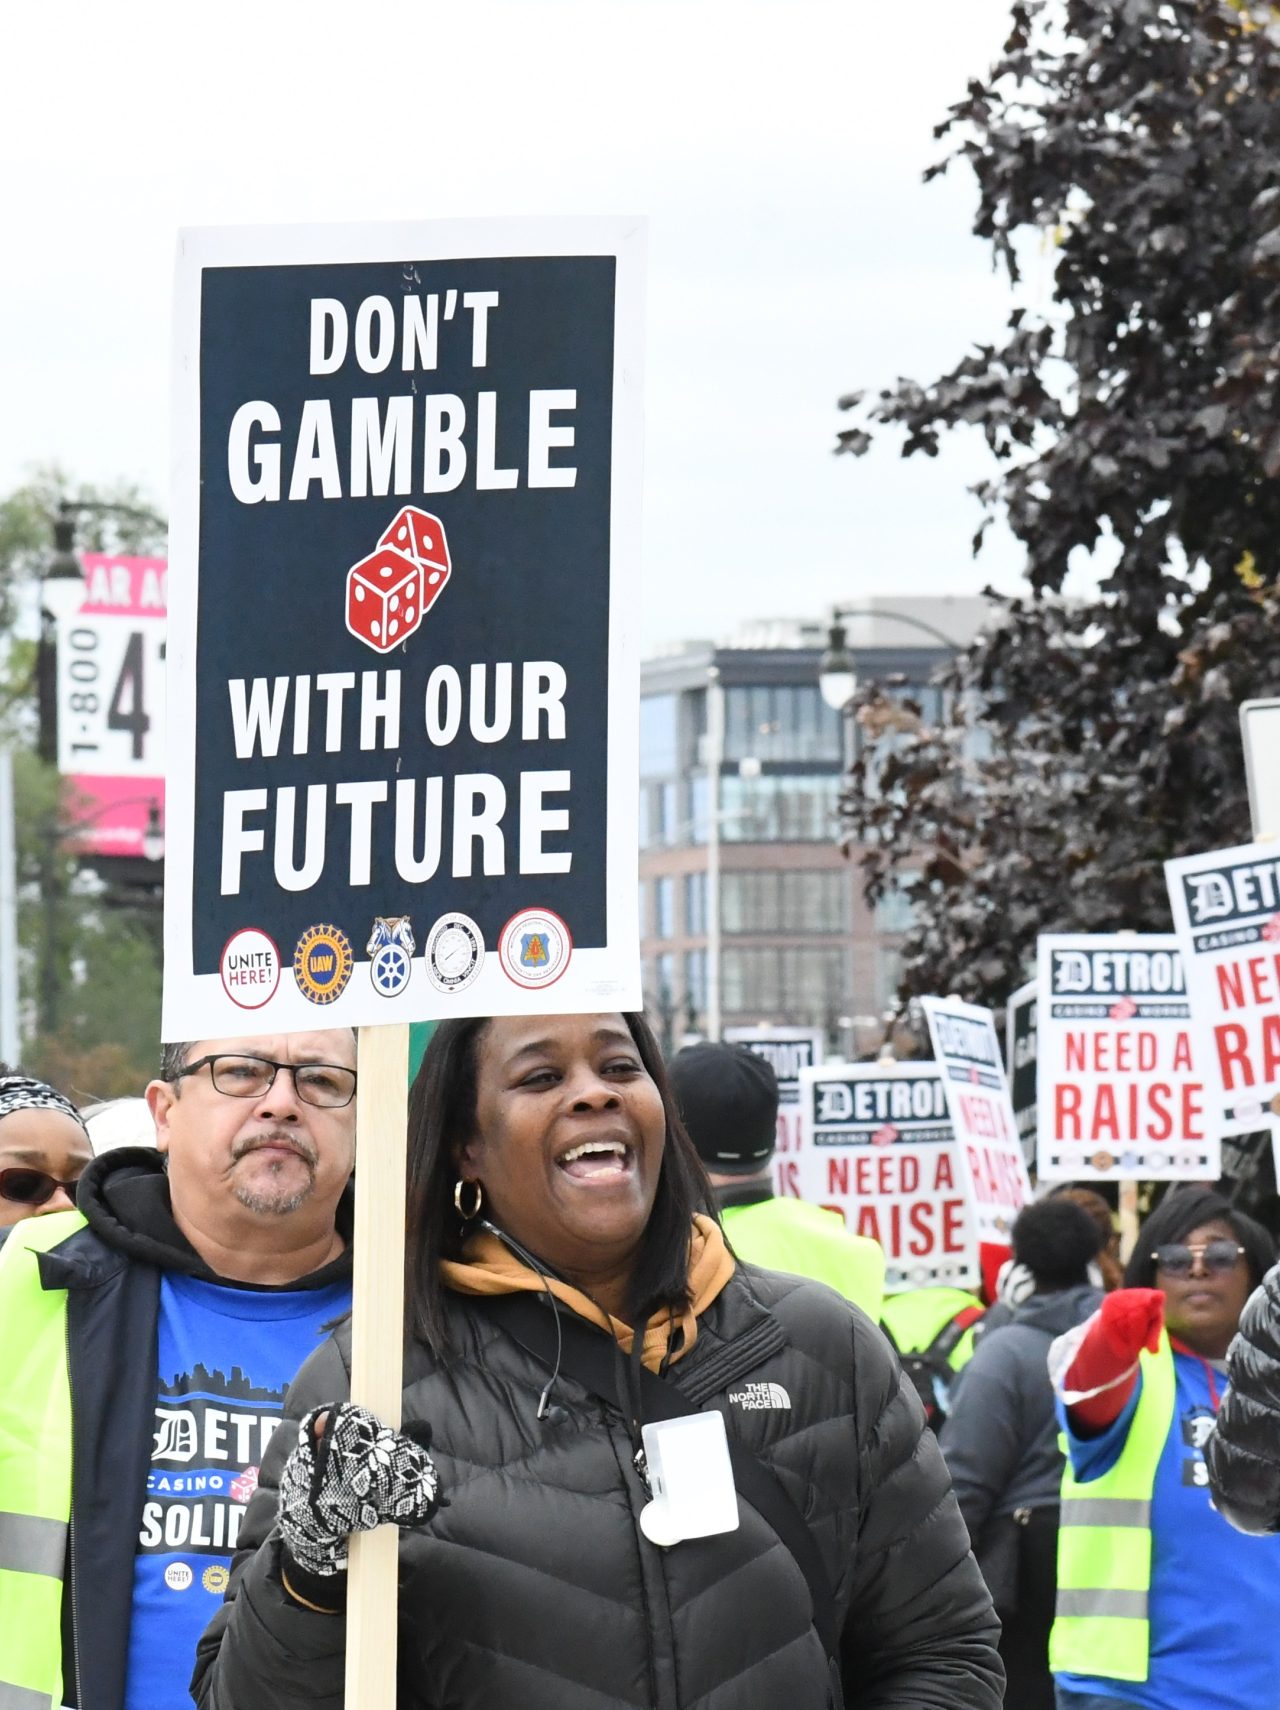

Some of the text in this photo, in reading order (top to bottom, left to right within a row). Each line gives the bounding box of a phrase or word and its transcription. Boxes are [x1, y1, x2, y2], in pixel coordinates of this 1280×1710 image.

[310, 289, 499, 376] DON'T
[228, 389, 577, 504] GAMBLE
[70, 628, 98, 753] 1-800
[107, 632, 166, 760] 4
[228, 660, 568, 759] WITH OUR
[220, 770, 573, 896] FUTURE
[1186, 862, 1280, 923] DET
[228, 951, 272, 970] UNITE
[1198, 927, 1258, 950] CASINO
[229, 968, 272, 986] HERE!
[310, 955, 333, 973] UAW
[1065, 1032, 1158, 1072] NEED
[1172, 1032, 1193, 1072] A
[1055, 1083, 1204, 1140] RAISE
[827, 1152, 955, 1195] NEED A
[818, 1199, 965, 1259] AISE
[729, 1391, 770, 1404] NORTH
[742, 1400, 771, 1410] FACE
[745, 1382, 768, 1392] THE
